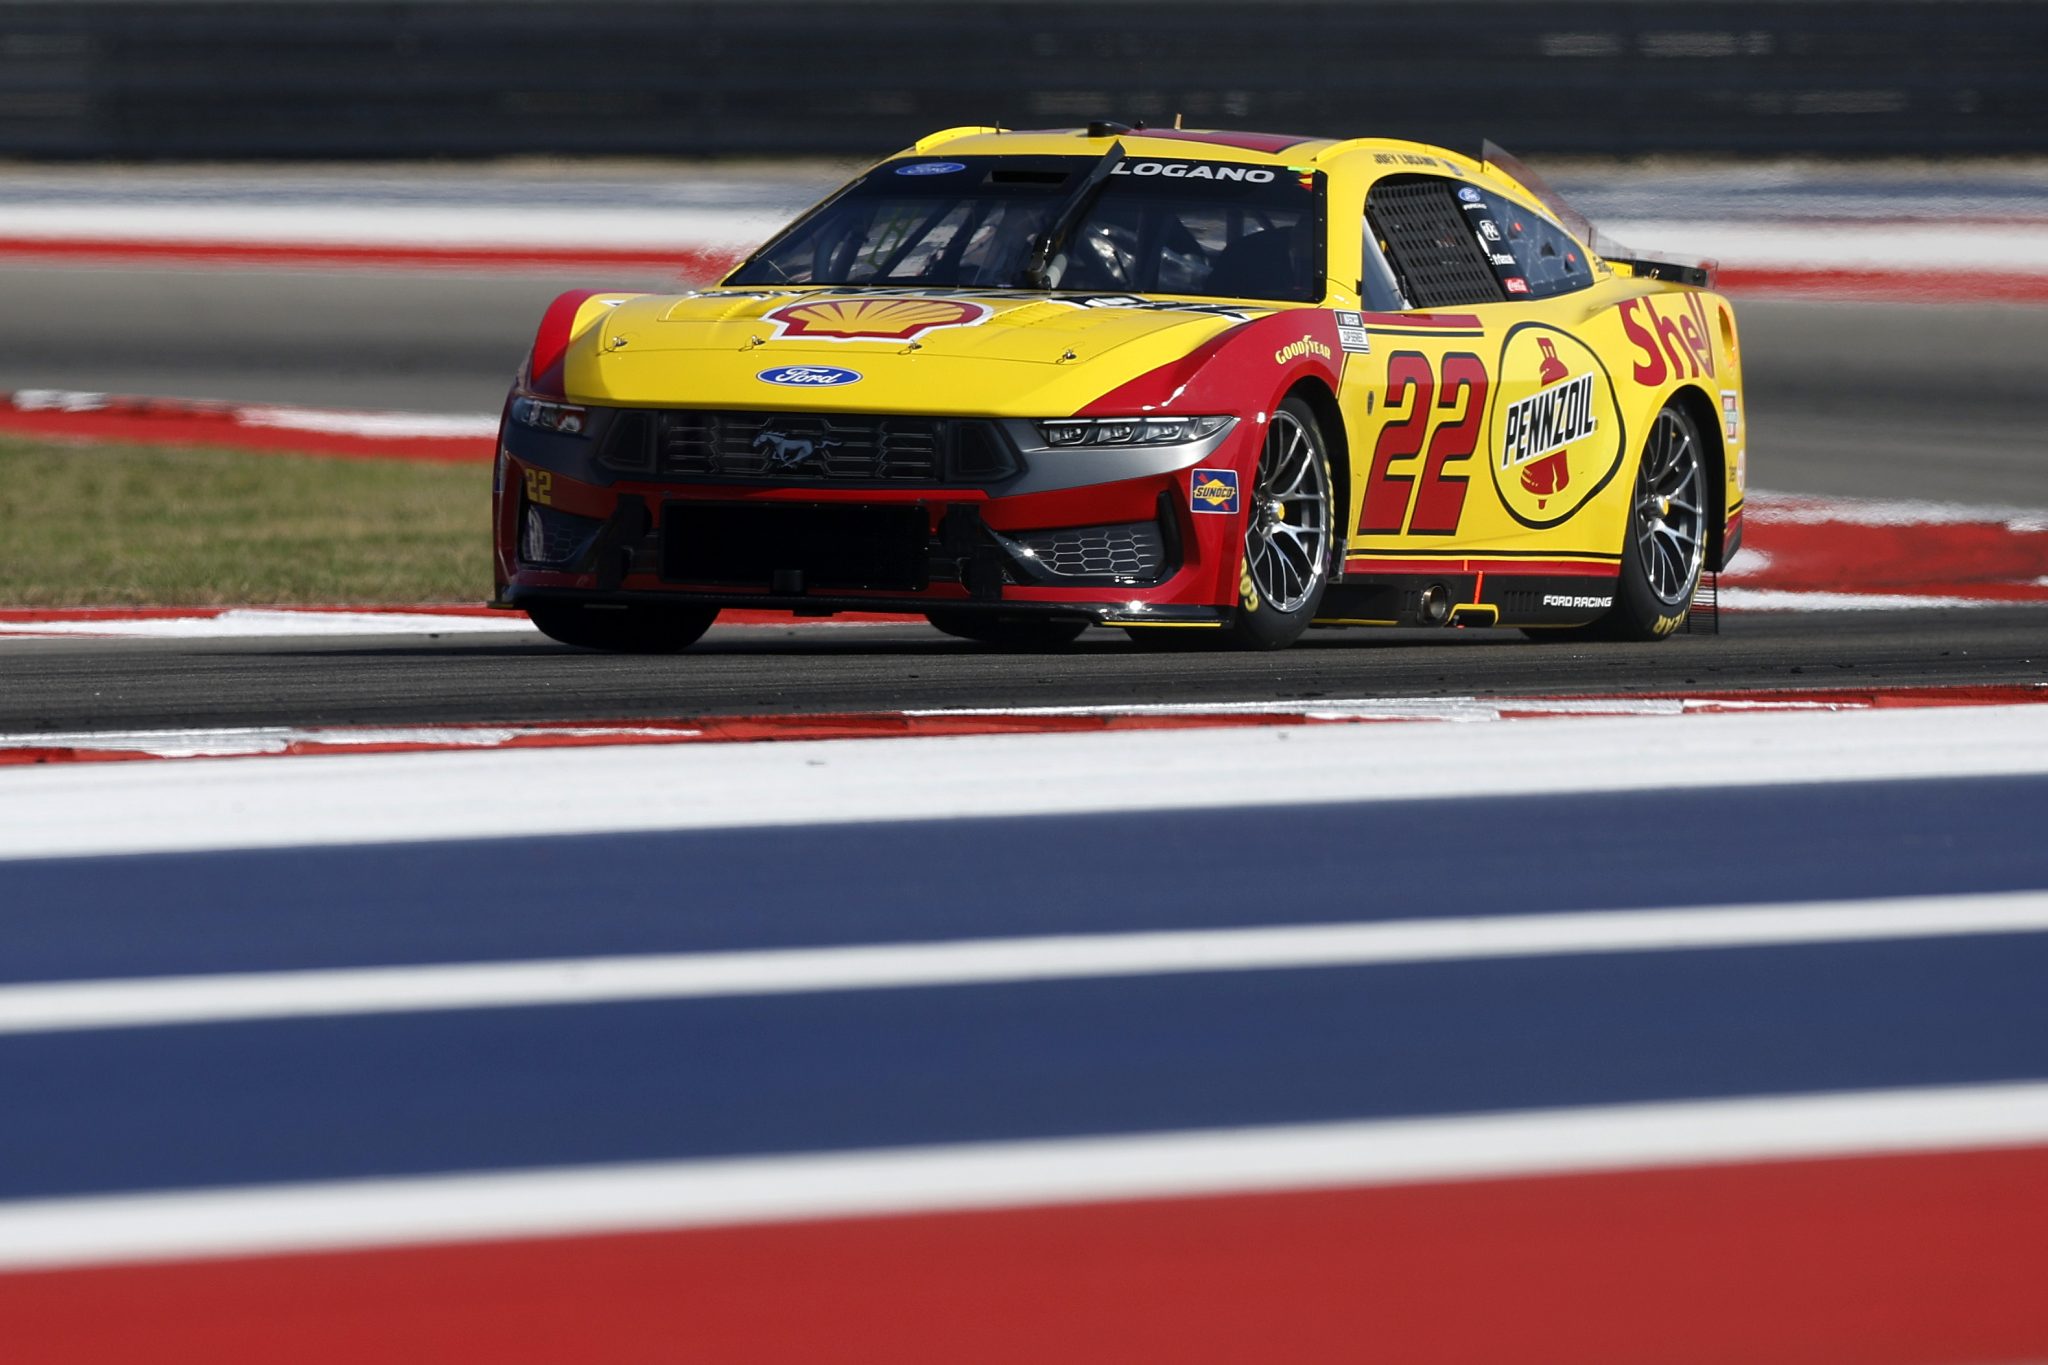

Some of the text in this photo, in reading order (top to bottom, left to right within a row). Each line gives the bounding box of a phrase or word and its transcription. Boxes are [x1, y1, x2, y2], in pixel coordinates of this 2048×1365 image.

[1110, 161, 1275, 183] LOGANO
[1275, 334, 1331, 365] GOODYEAR
[775, 367, 843, 384] Ford
[1502, 375, 1594, 467] PENNZOIL
[1357, 350, 1489, 536] 22
[525, 468, 552, 505] 22
[1195, 486, 1234, 498] SUNOCO
[1543, 595, 1613, 607] FORD RACING
